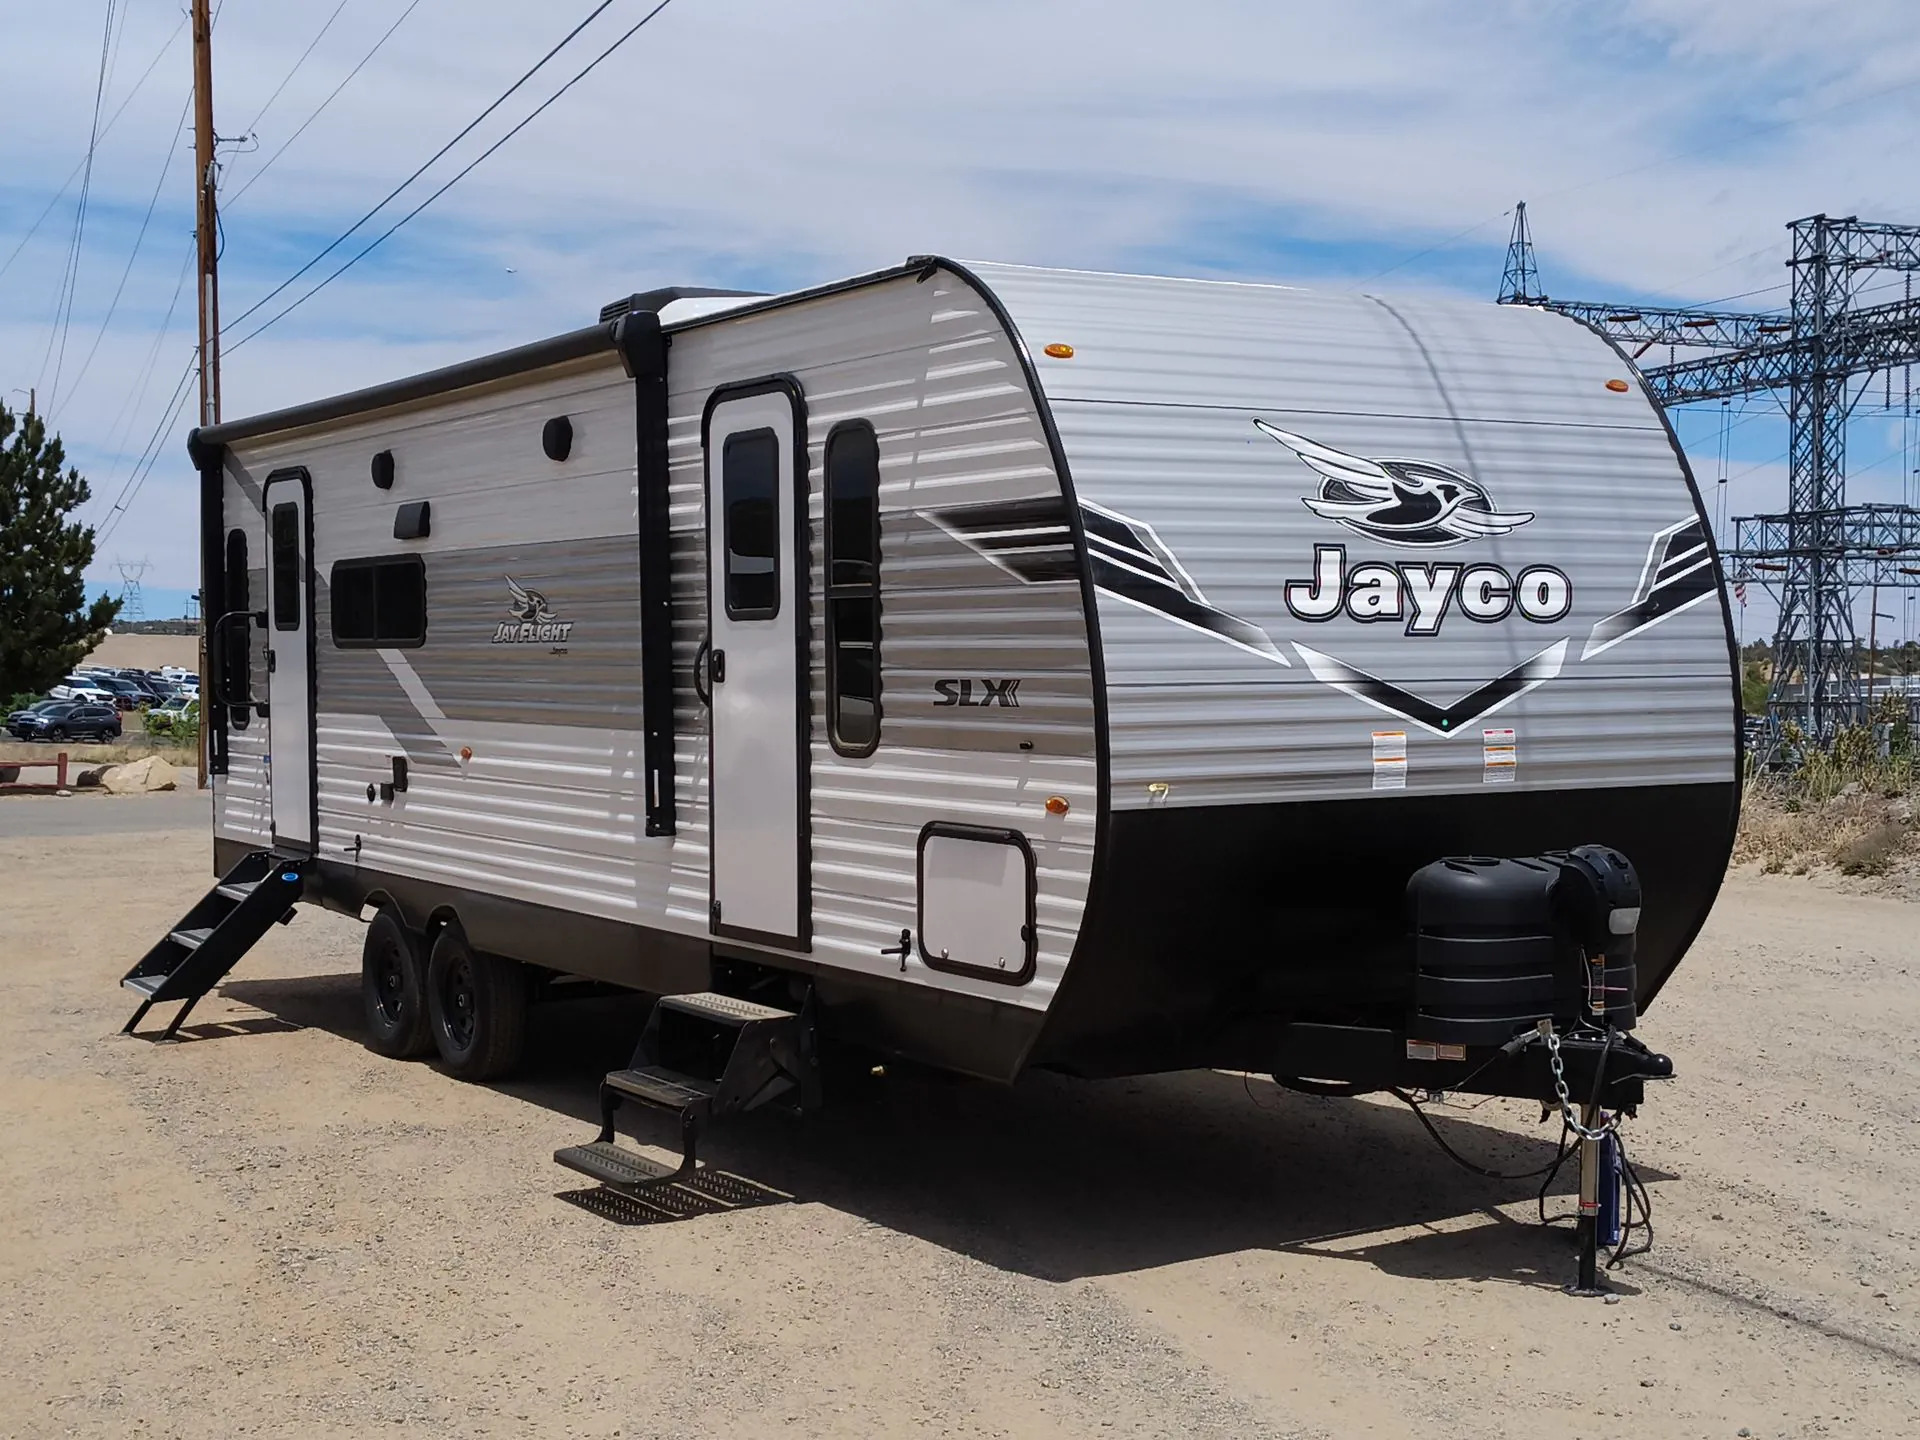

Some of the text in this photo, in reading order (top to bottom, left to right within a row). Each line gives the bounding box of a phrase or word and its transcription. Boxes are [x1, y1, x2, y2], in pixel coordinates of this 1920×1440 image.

[1284, 543, 1572, 637] Jayco
[491, 621, 574, 643] JAY FLIGHT
[933, 679, 1021, 707] SLX
